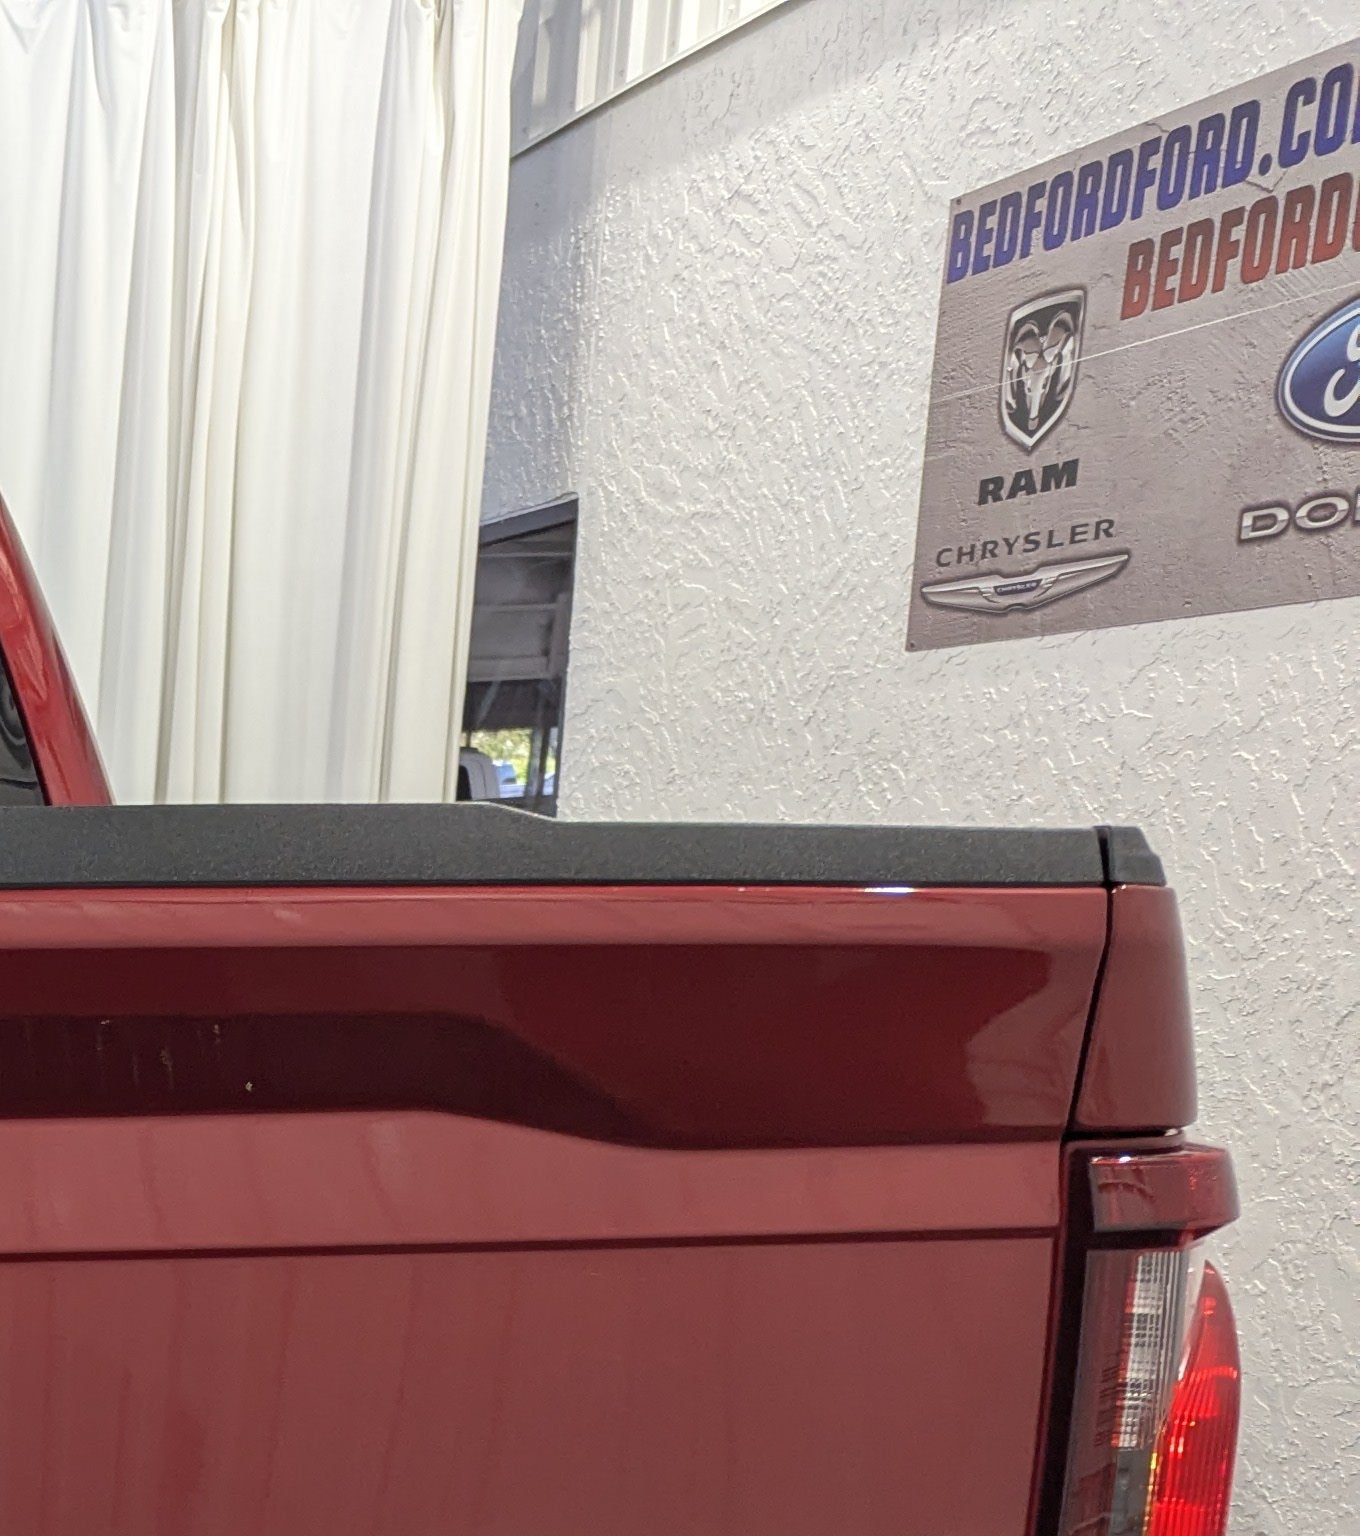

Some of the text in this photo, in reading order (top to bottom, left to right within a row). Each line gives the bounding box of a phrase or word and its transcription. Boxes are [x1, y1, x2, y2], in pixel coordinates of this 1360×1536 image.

[947, 62, 1360, 283] BEDFORDFORD.CO
[1120, 172, 1360, 320] BEDFORD
[978, 458, 1079, 506] RAM
[1239, 487, 1360, 541] DO
[936, 518, 1115, 568] CHRYSLER
